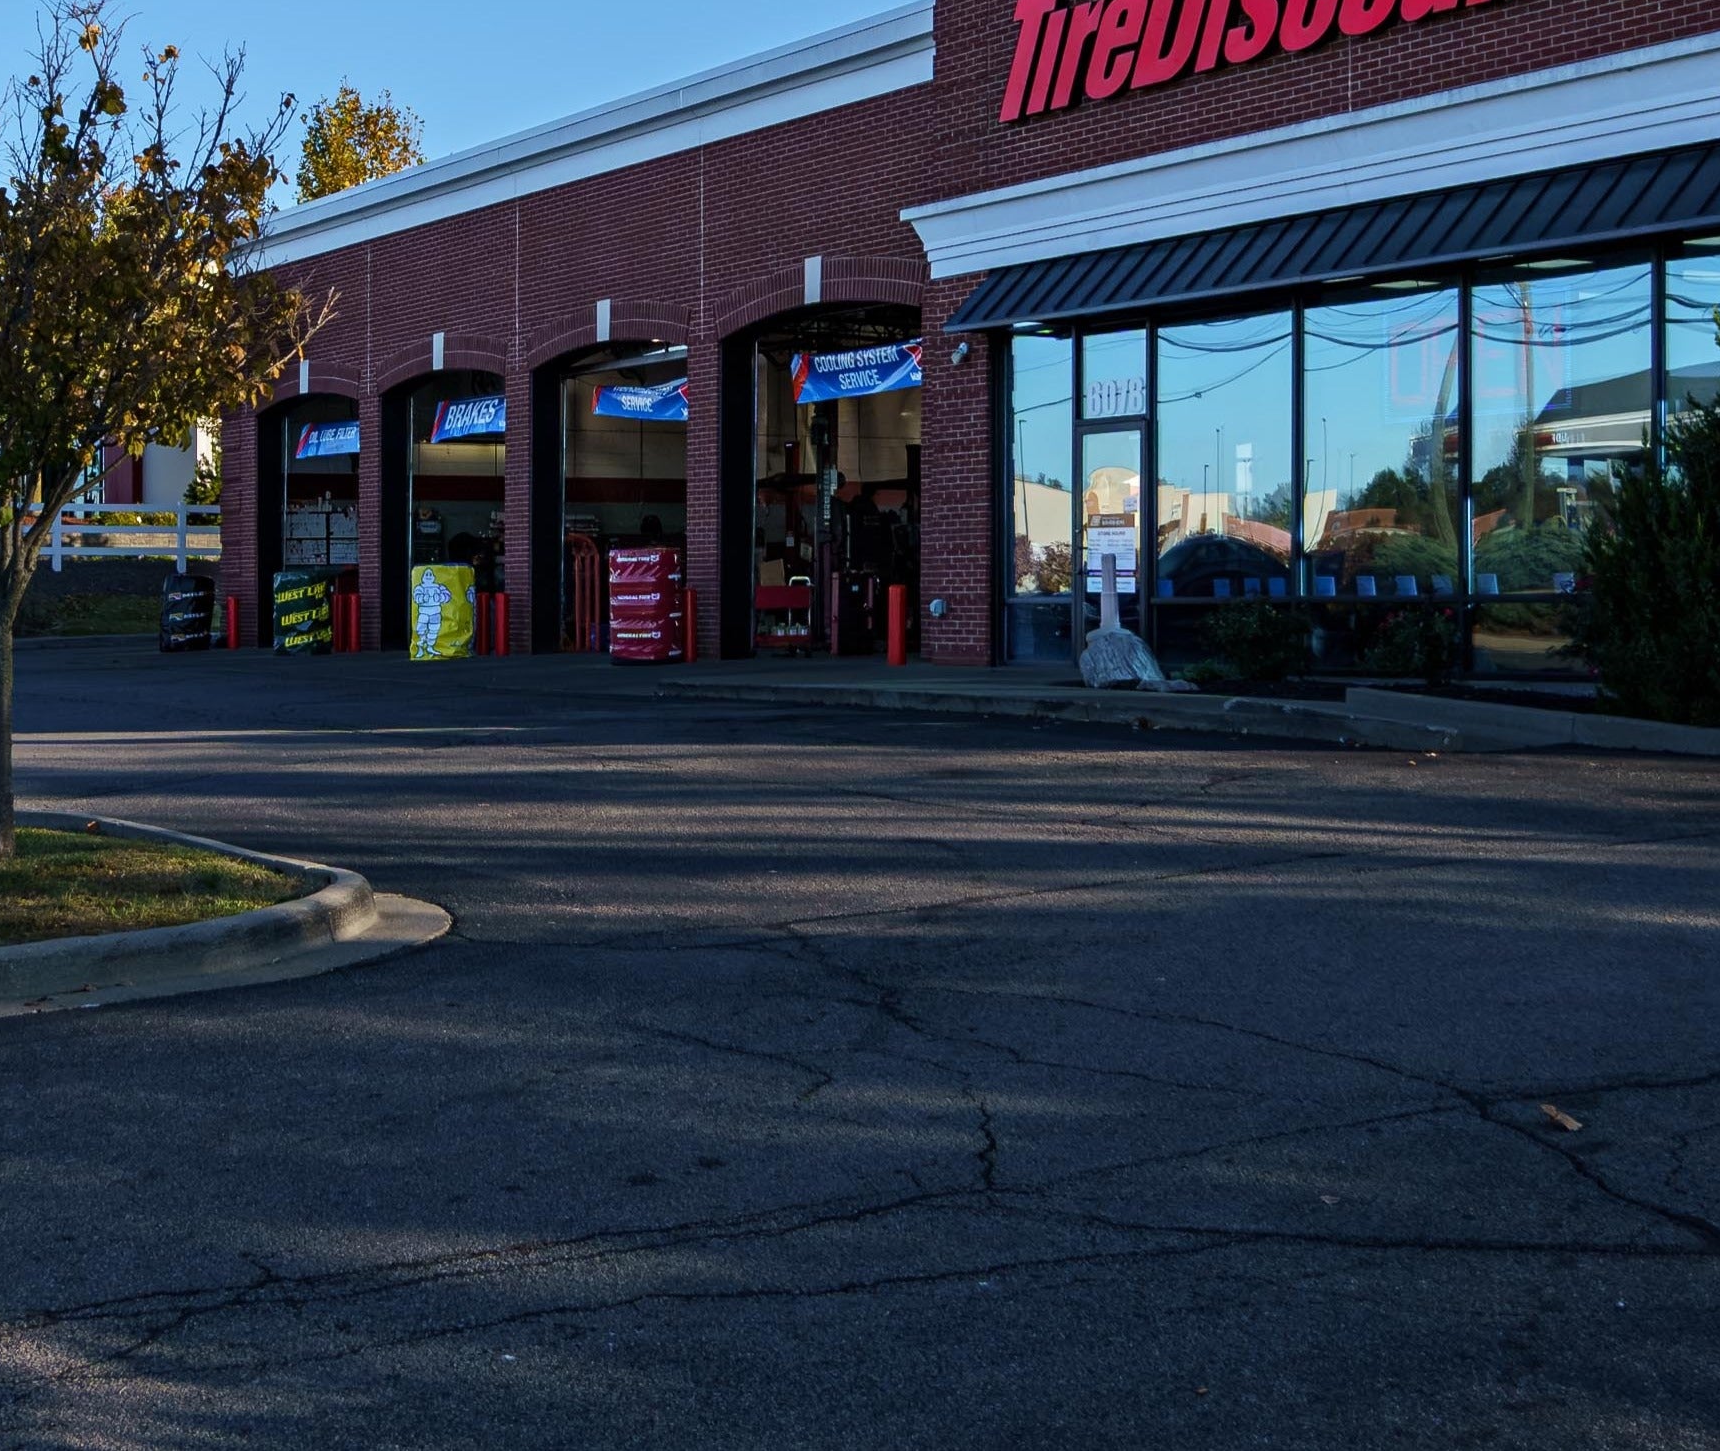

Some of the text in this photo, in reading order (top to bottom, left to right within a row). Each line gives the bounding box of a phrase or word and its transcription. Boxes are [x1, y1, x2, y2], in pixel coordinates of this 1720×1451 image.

[814, 345, 900, 373] COOLING SYSTEM
[838, 369, 882, 390] SERVICE
[445, 398, 499, 430] BRAKES
[621, 395, 653, 412] SERVICE
